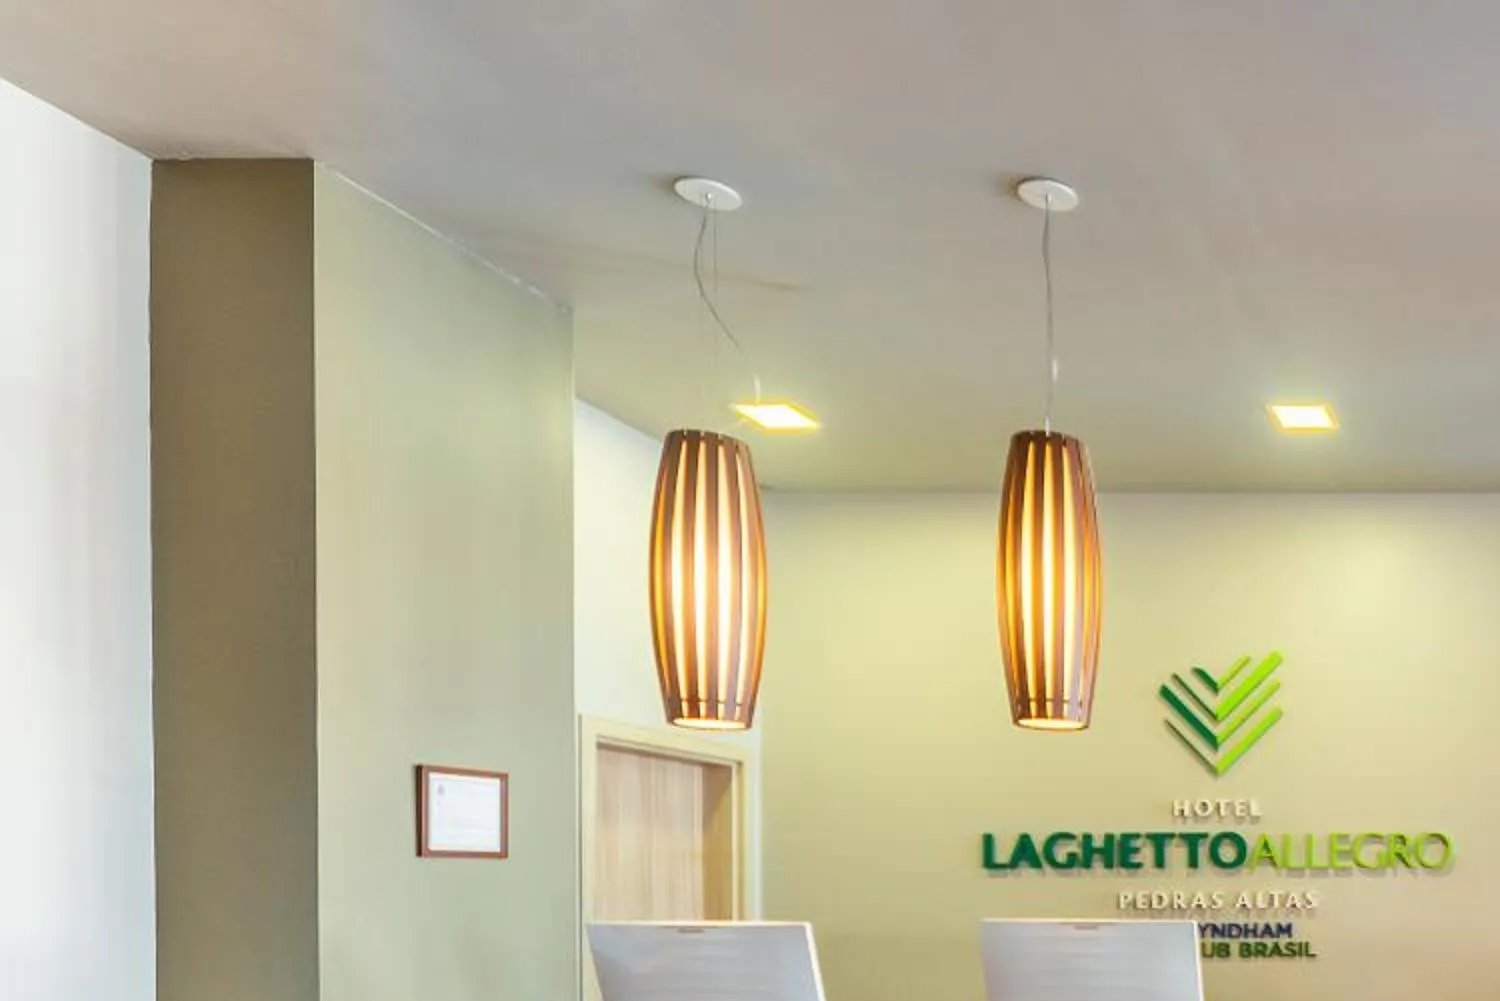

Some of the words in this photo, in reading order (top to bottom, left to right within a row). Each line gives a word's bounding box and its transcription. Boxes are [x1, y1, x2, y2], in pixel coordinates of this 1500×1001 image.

[1172, 799, 1262, 818] HOTEL
[1118, 890, 1224, 910] PEDRAS
[1235, 890, 1318, 910] ALTAS
[1198, 922, 1293, 939] YNDHAM
[1201, 941, 1231, 958] UB
[1238, 941, 1318, 958] BRASIL
